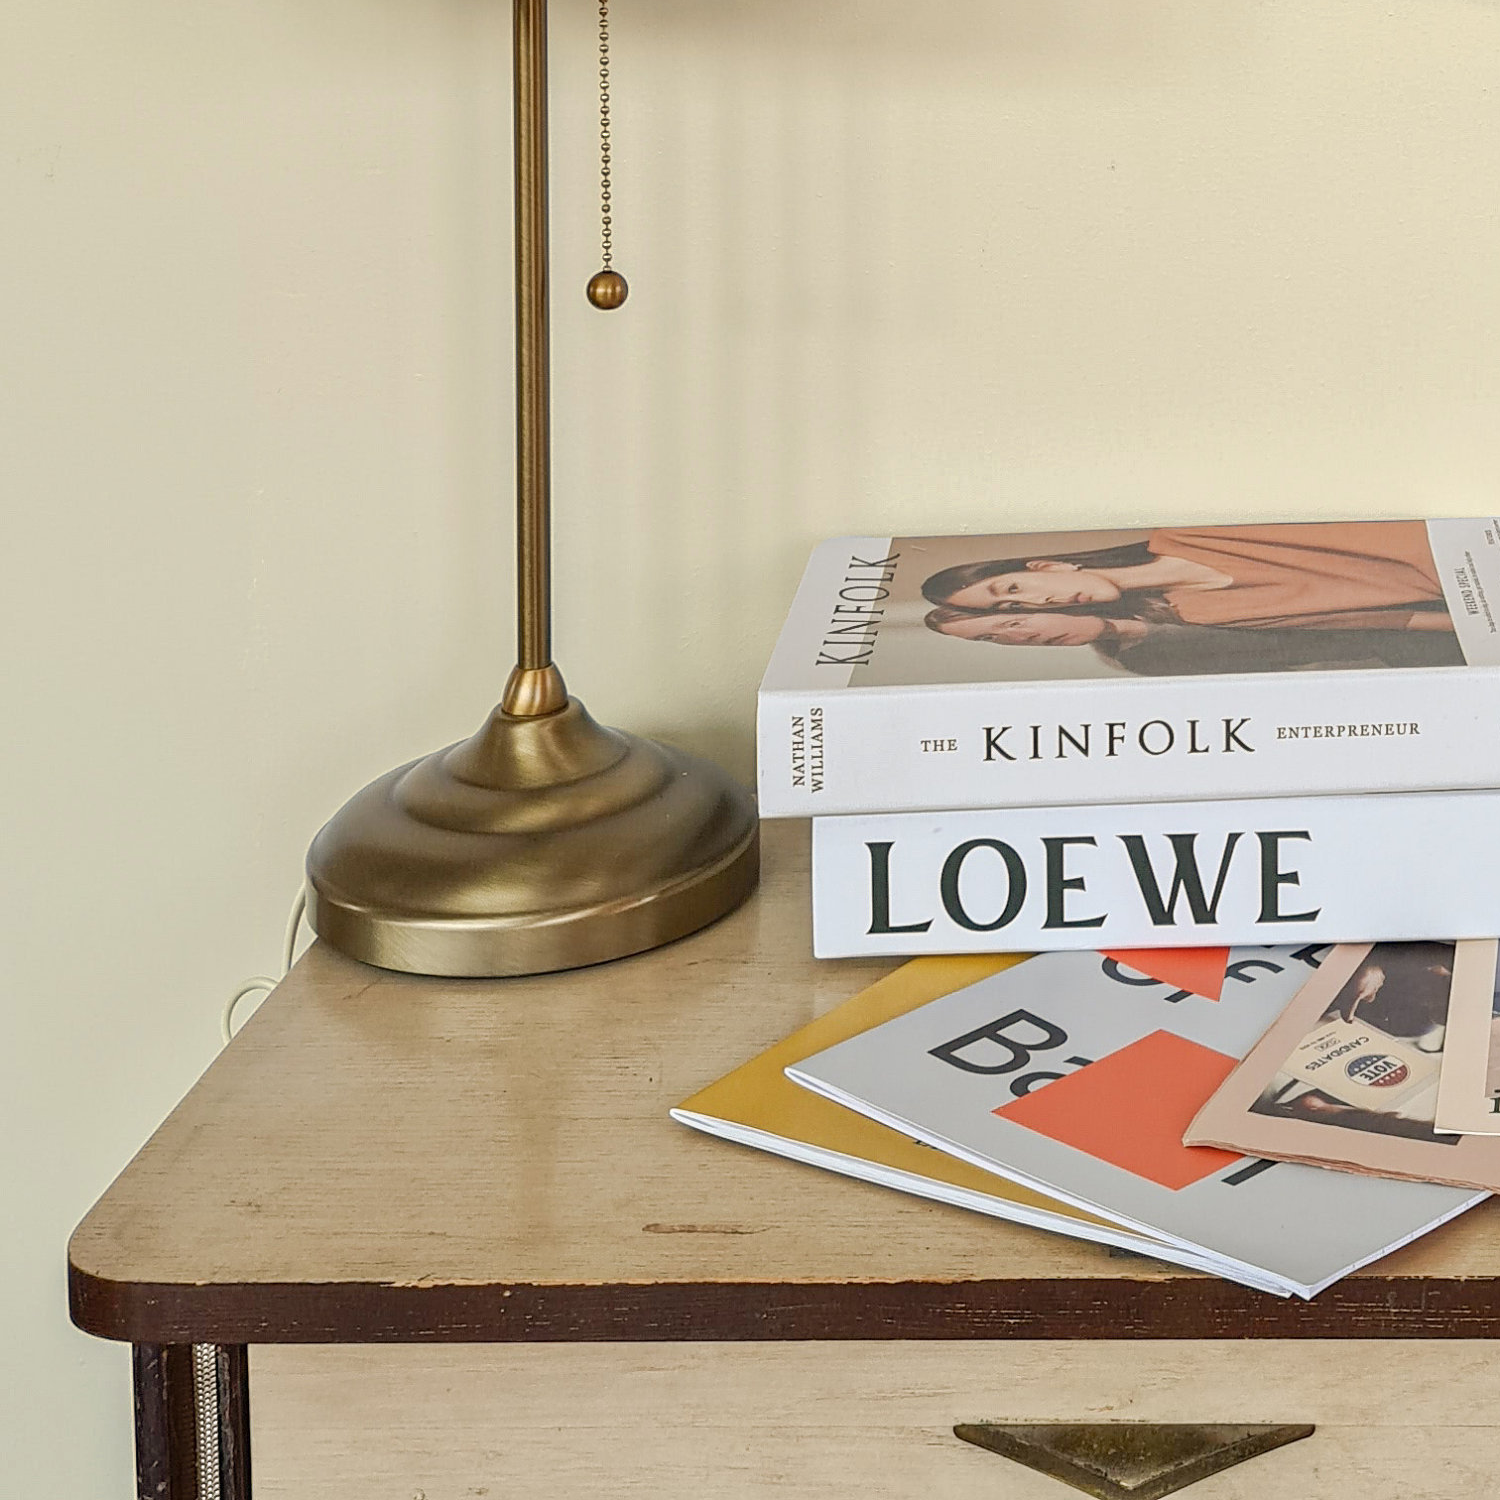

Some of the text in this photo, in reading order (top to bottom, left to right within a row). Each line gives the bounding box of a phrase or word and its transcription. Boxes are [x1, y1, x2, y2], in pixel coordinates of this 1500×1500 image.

[815, 553, 901, 666] KINFOLK
[791, 715, 805, 787] NATHAN
[810, 706, 824, 793] WILLIAMS
[920, 717, 1421, 762] THE KINFOLK ENTERPRENEUR
[864, 830, 1322, 935] LOEWE
[1305, 1036, 1370, 1071] CANDIDATES
[1360, 1060, 1398, 1081] VOTE
